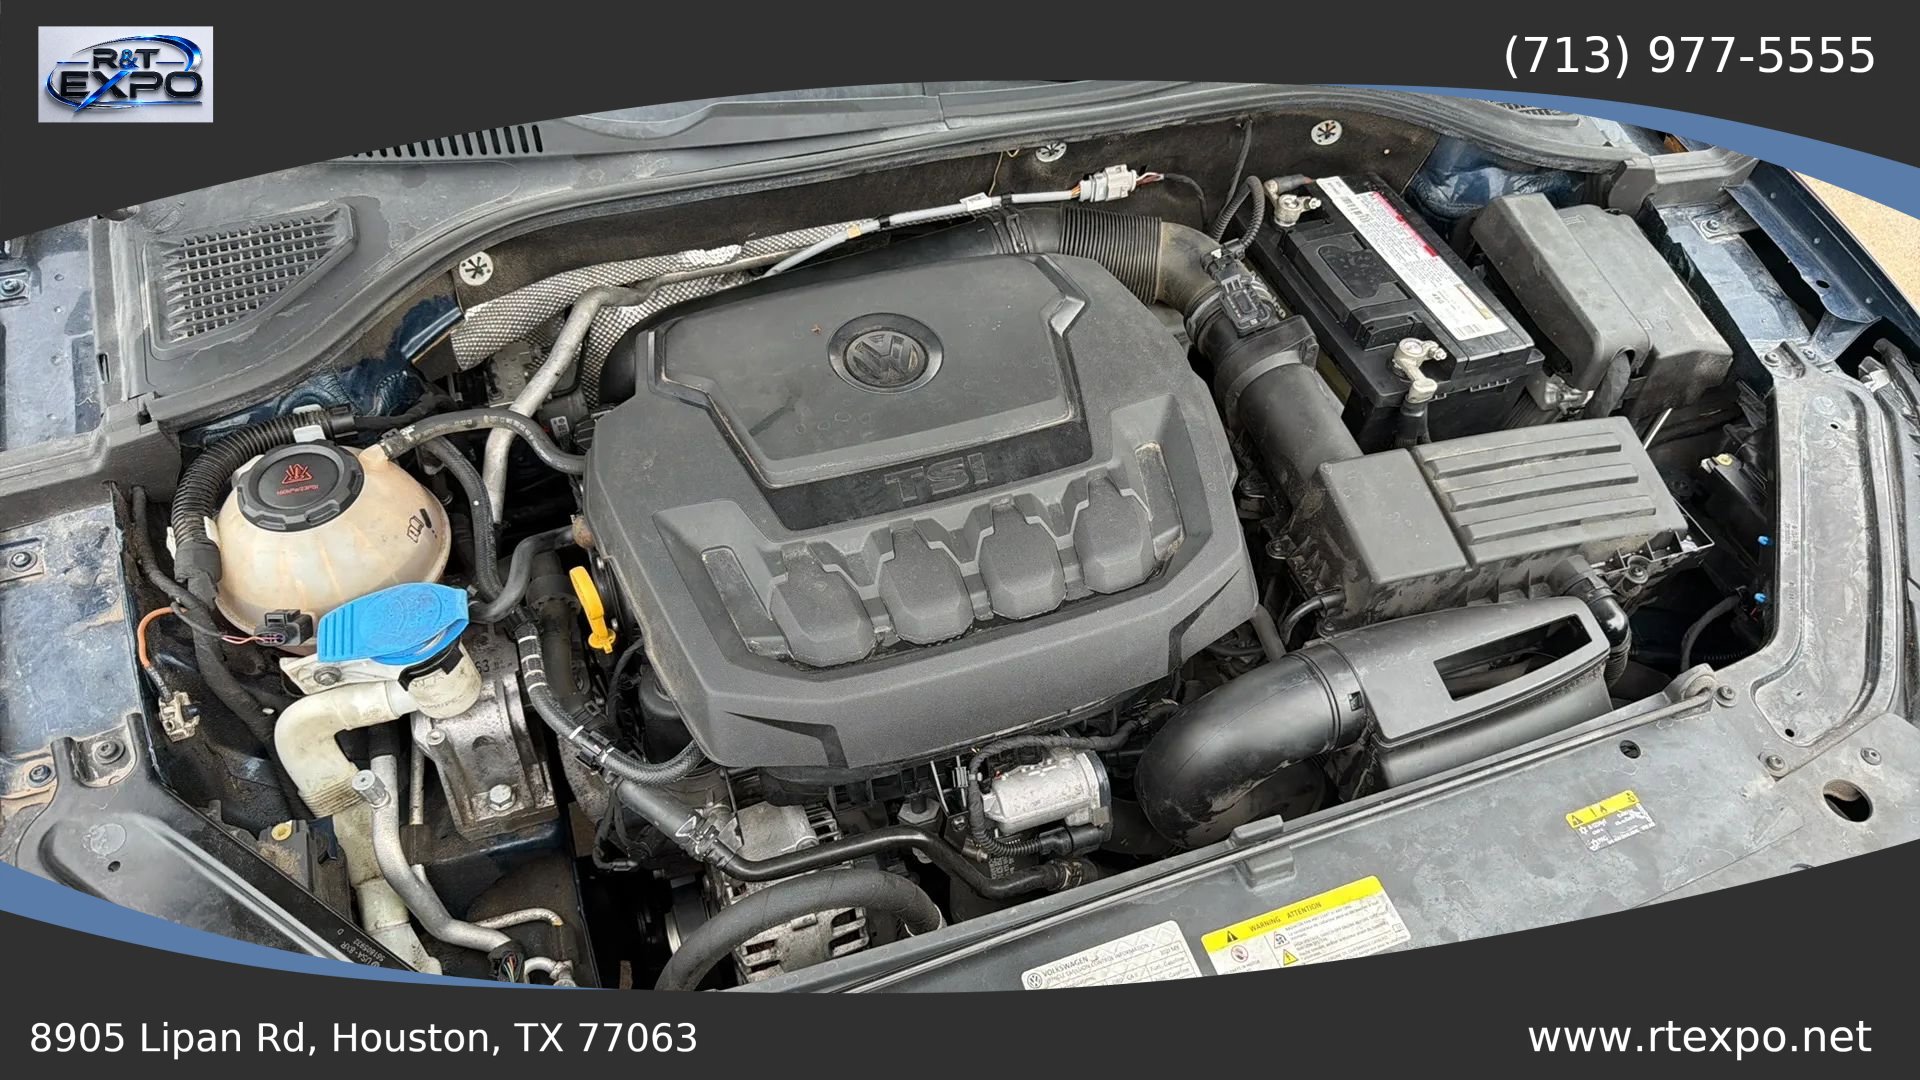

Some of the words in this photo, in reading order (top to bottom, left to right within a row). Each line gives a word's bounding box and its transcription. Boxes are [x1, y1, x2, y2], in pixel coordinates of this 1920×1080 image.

[884, 452, 989, 502] TSI
[1249, 917, 1281, 933] WARNING
[1287, 902, 1322, 919] ATTENTION
[1043, 956, 1089, 976] VOLKSWAGEN
